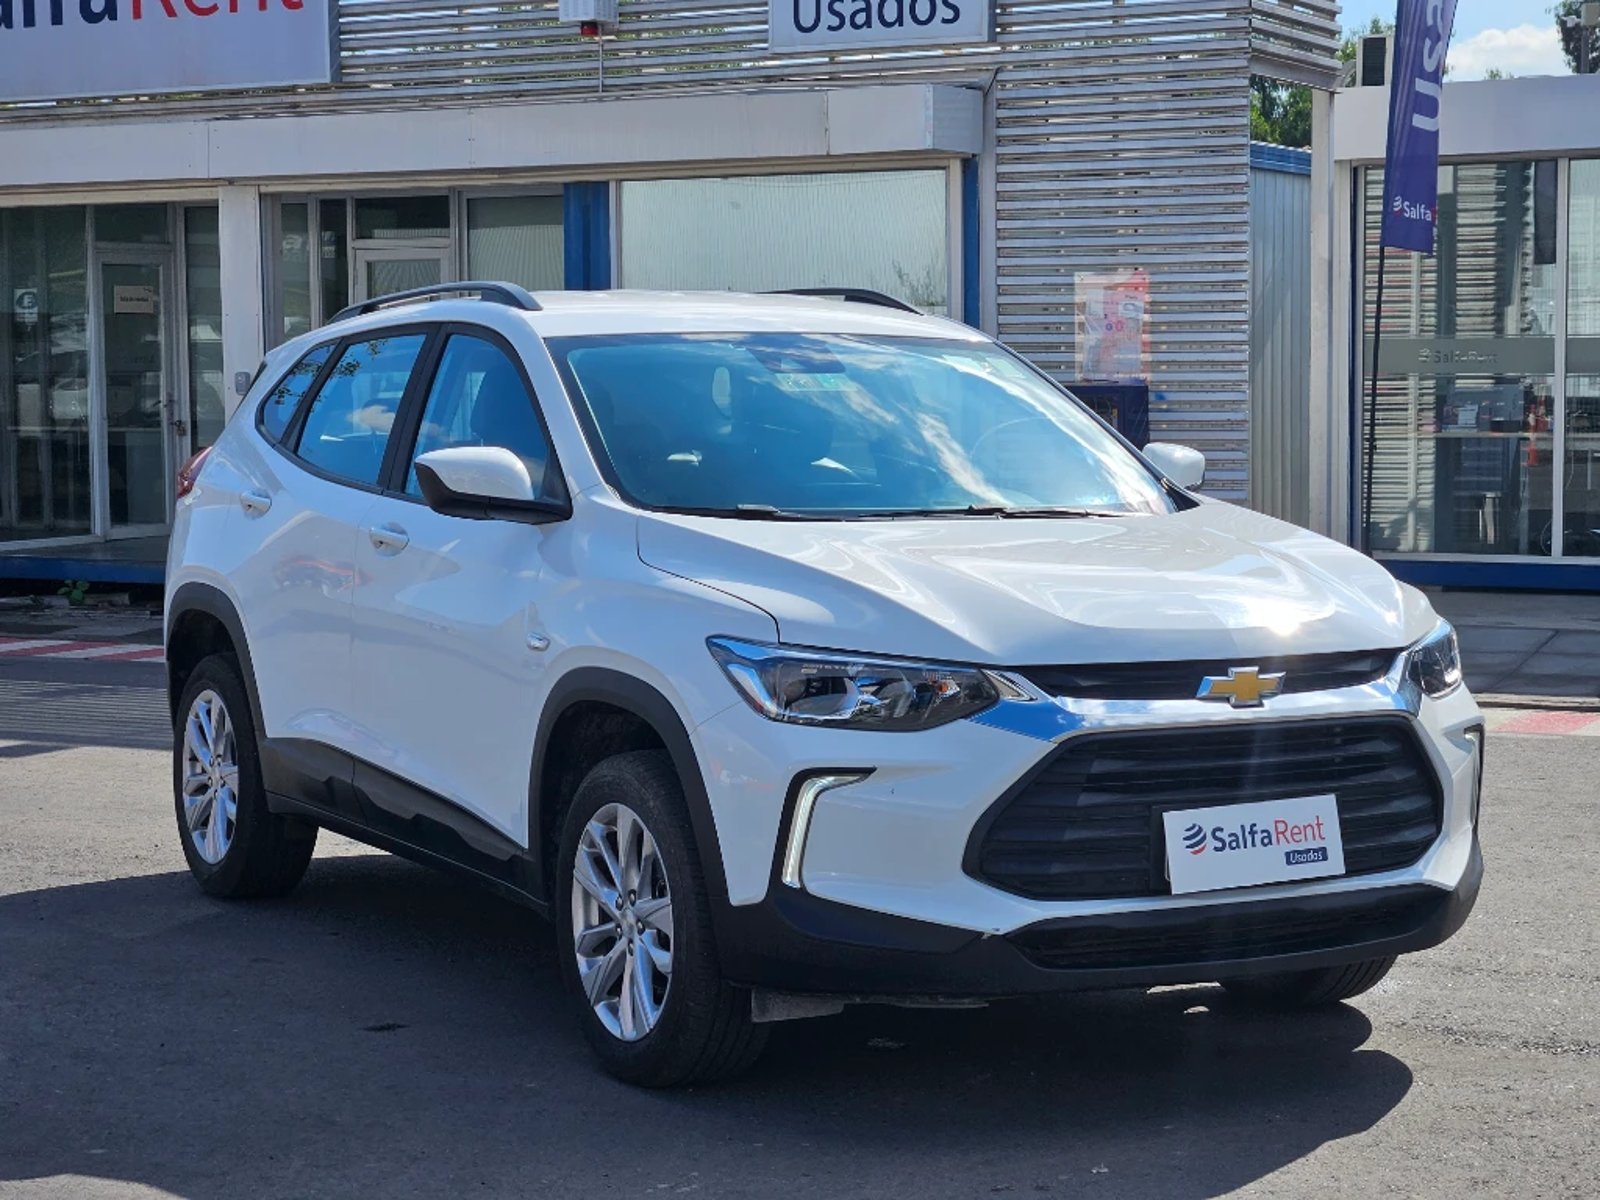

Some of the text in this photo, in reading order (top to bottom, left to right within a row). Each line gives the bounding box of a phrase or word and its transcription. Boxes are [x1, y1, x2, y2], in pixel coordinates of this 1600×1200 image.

[793, 0, 961, 33] Usados
[1403, 201, 1432, 221] Salfa
[1211, 815, 1326, 852] SalfaRent
[1290, 850, 1323, 863] Usados
